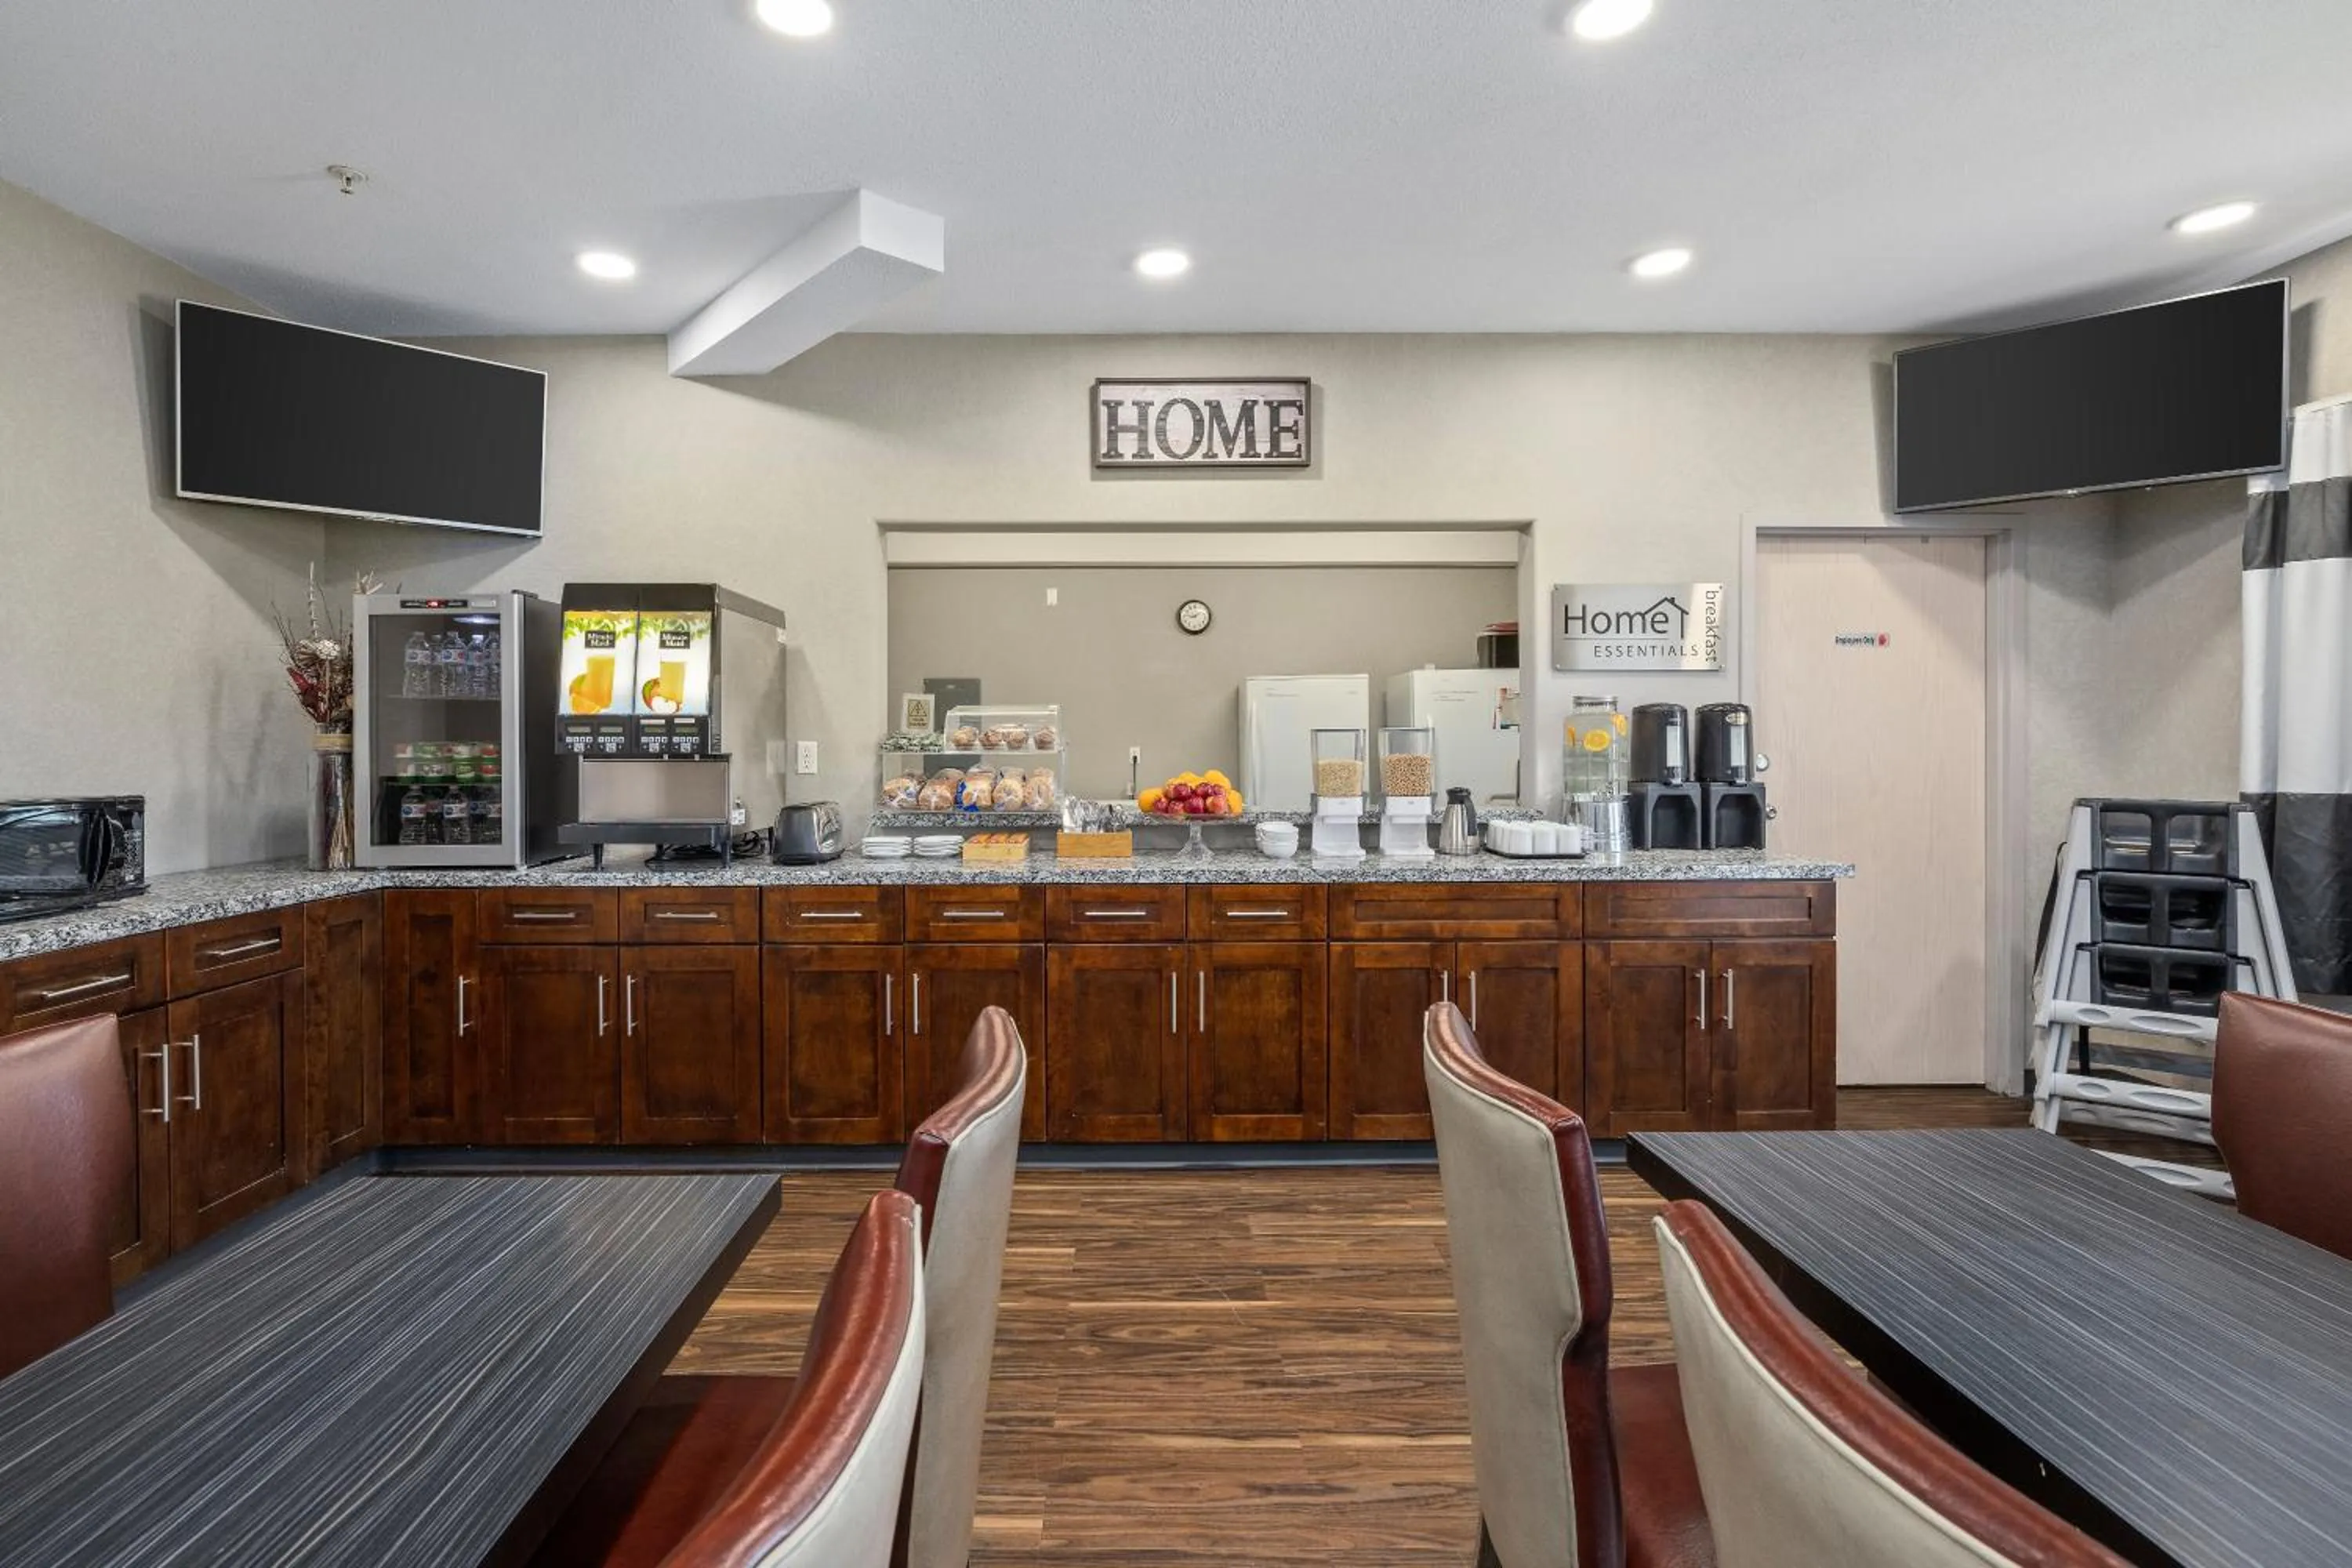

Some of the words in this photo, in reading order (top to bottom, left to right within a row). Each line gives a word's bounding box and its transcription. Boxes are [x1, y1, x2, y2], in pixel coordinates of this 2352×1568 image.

[1102, 397, 1304, 459] HOME
[1563, 604, 1669, 634] Home
[1704, 590, 1722, 662] breakfast
[1594, 644, 1699, 658] ESSENTIALS
